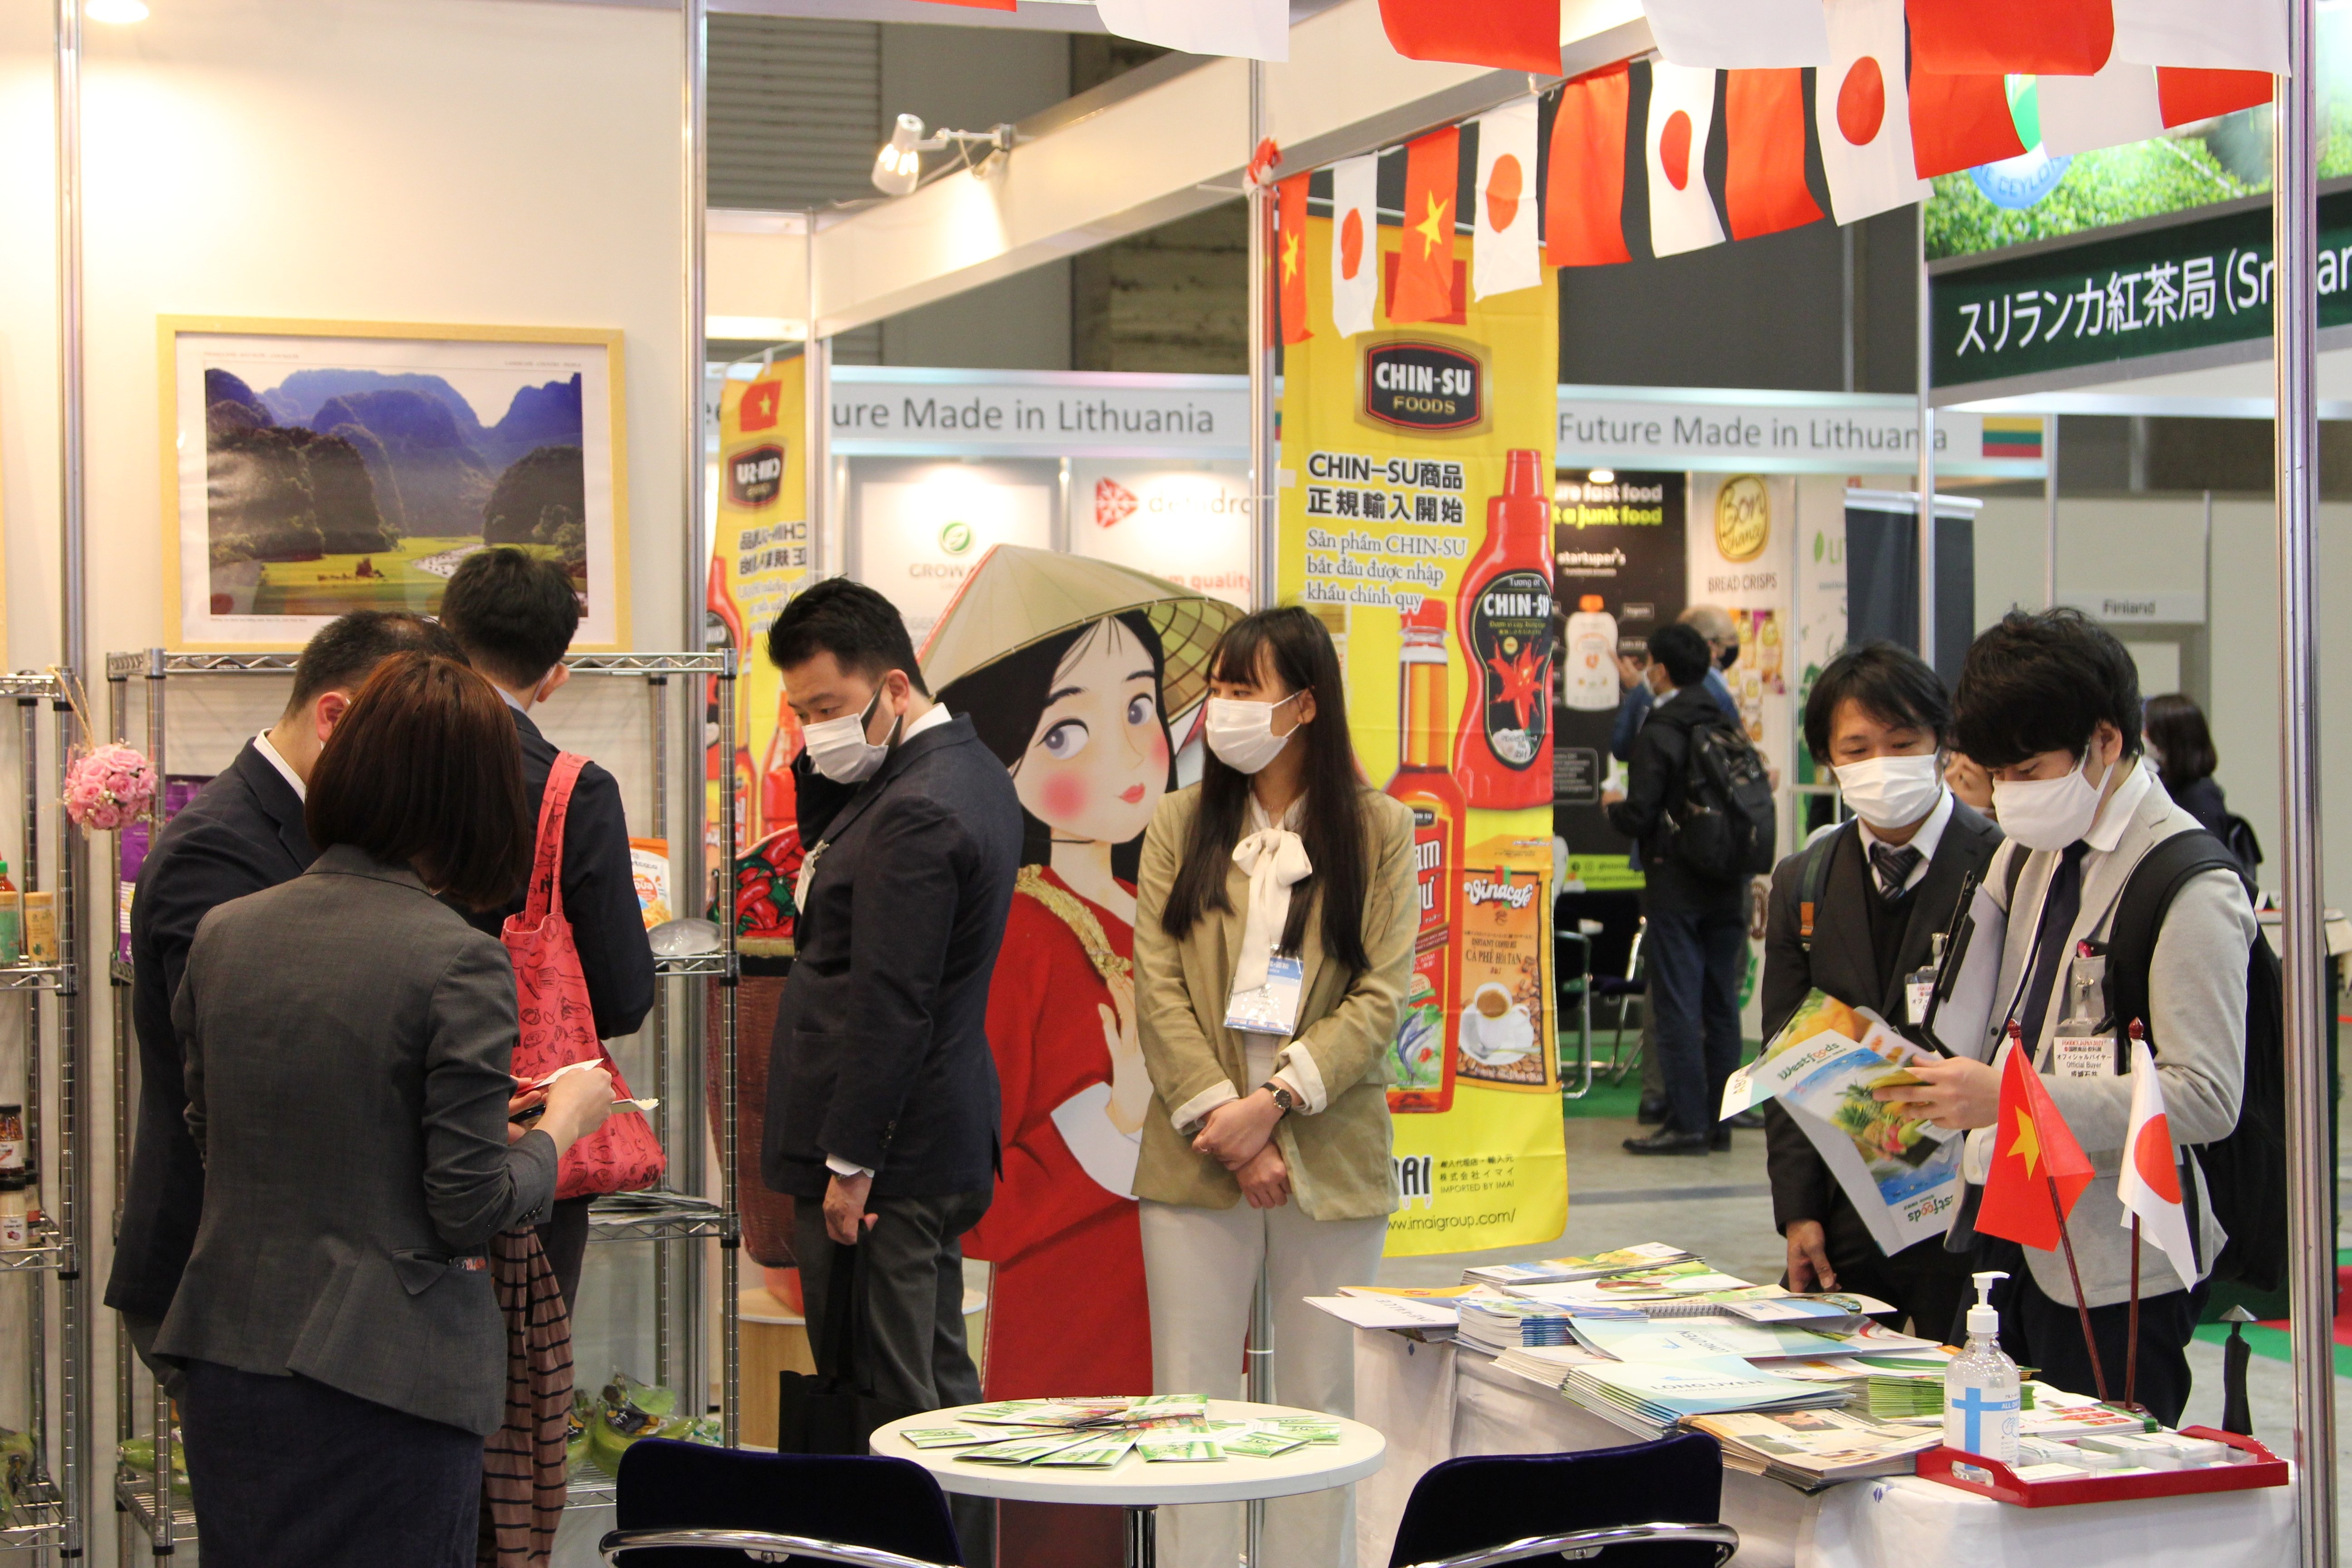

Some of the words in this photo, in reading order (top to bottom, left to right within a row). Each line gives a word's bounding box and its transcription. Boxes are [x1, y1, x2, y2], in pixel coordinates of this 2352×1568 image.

[1956, 256, 2216, 358] スリランカ紅茶局
[2225, 247, 2274, 316] (Sr
[1375, 362, 1471, 397] CHIN-SU
[831, 401, 890, 427] ure
[903, 397, 1003, 431] Made
[1015, 398, 1045, 431] in
[1058, 400, 1214, 433] Lithuania
[1392, 395, 1456, 416] FOODS
[1559, 412, 1662, 444] Future
[1674, 415, 1762, 447] Made
[1773, 417, 1798, 447] in
[1810, 418, 1948, 450] Lithuana
[1308, 486, 1464, 523] 正規輸入開始
[1582, 481, 1620, 503] fast
[1621, 482, 1663, 503] food
[1576, 503, 1620, 530] junk
[1620, 505, 1663, 526] food
[1308, 529, 1336, 548] Sản
[1341, 531, 1382, 554] phẩm
[1386, 535, 1467, 556] CHIN-SU
[1307, 555, 1332, 574] bắt
[1336, 557, 1363, 576] đầu
[1367, 559, 1404, 583] được
[1406, 562, 1444, 587] nhập
[1708, 575, 1740, 595] BREAD
[1742, 573, 1779, 591] CRISPS
[1307, 582, 1346, 602] khẩu
[1350, 584, 1392, 604] chính
[1395, 593, 1423, 611] quy
[1483, 593, 1550, 618] CHIN-SU
[2102, 598, 2156, 615] Finland
[1472, 937, 1494, 947] INSTANT
[1441, 1182, 1481, 1194] IMPORTED
[1483, 1182, 1494, 1191] BY
[1496, 1180, 1514, 1189] IMAI
[1388, 1207, 1516, 1232] ww.imaigroup.com/
[1907, 1195, 1953, 1223] stfoods
[1707, 1379, 1765, 1387] UYEN
